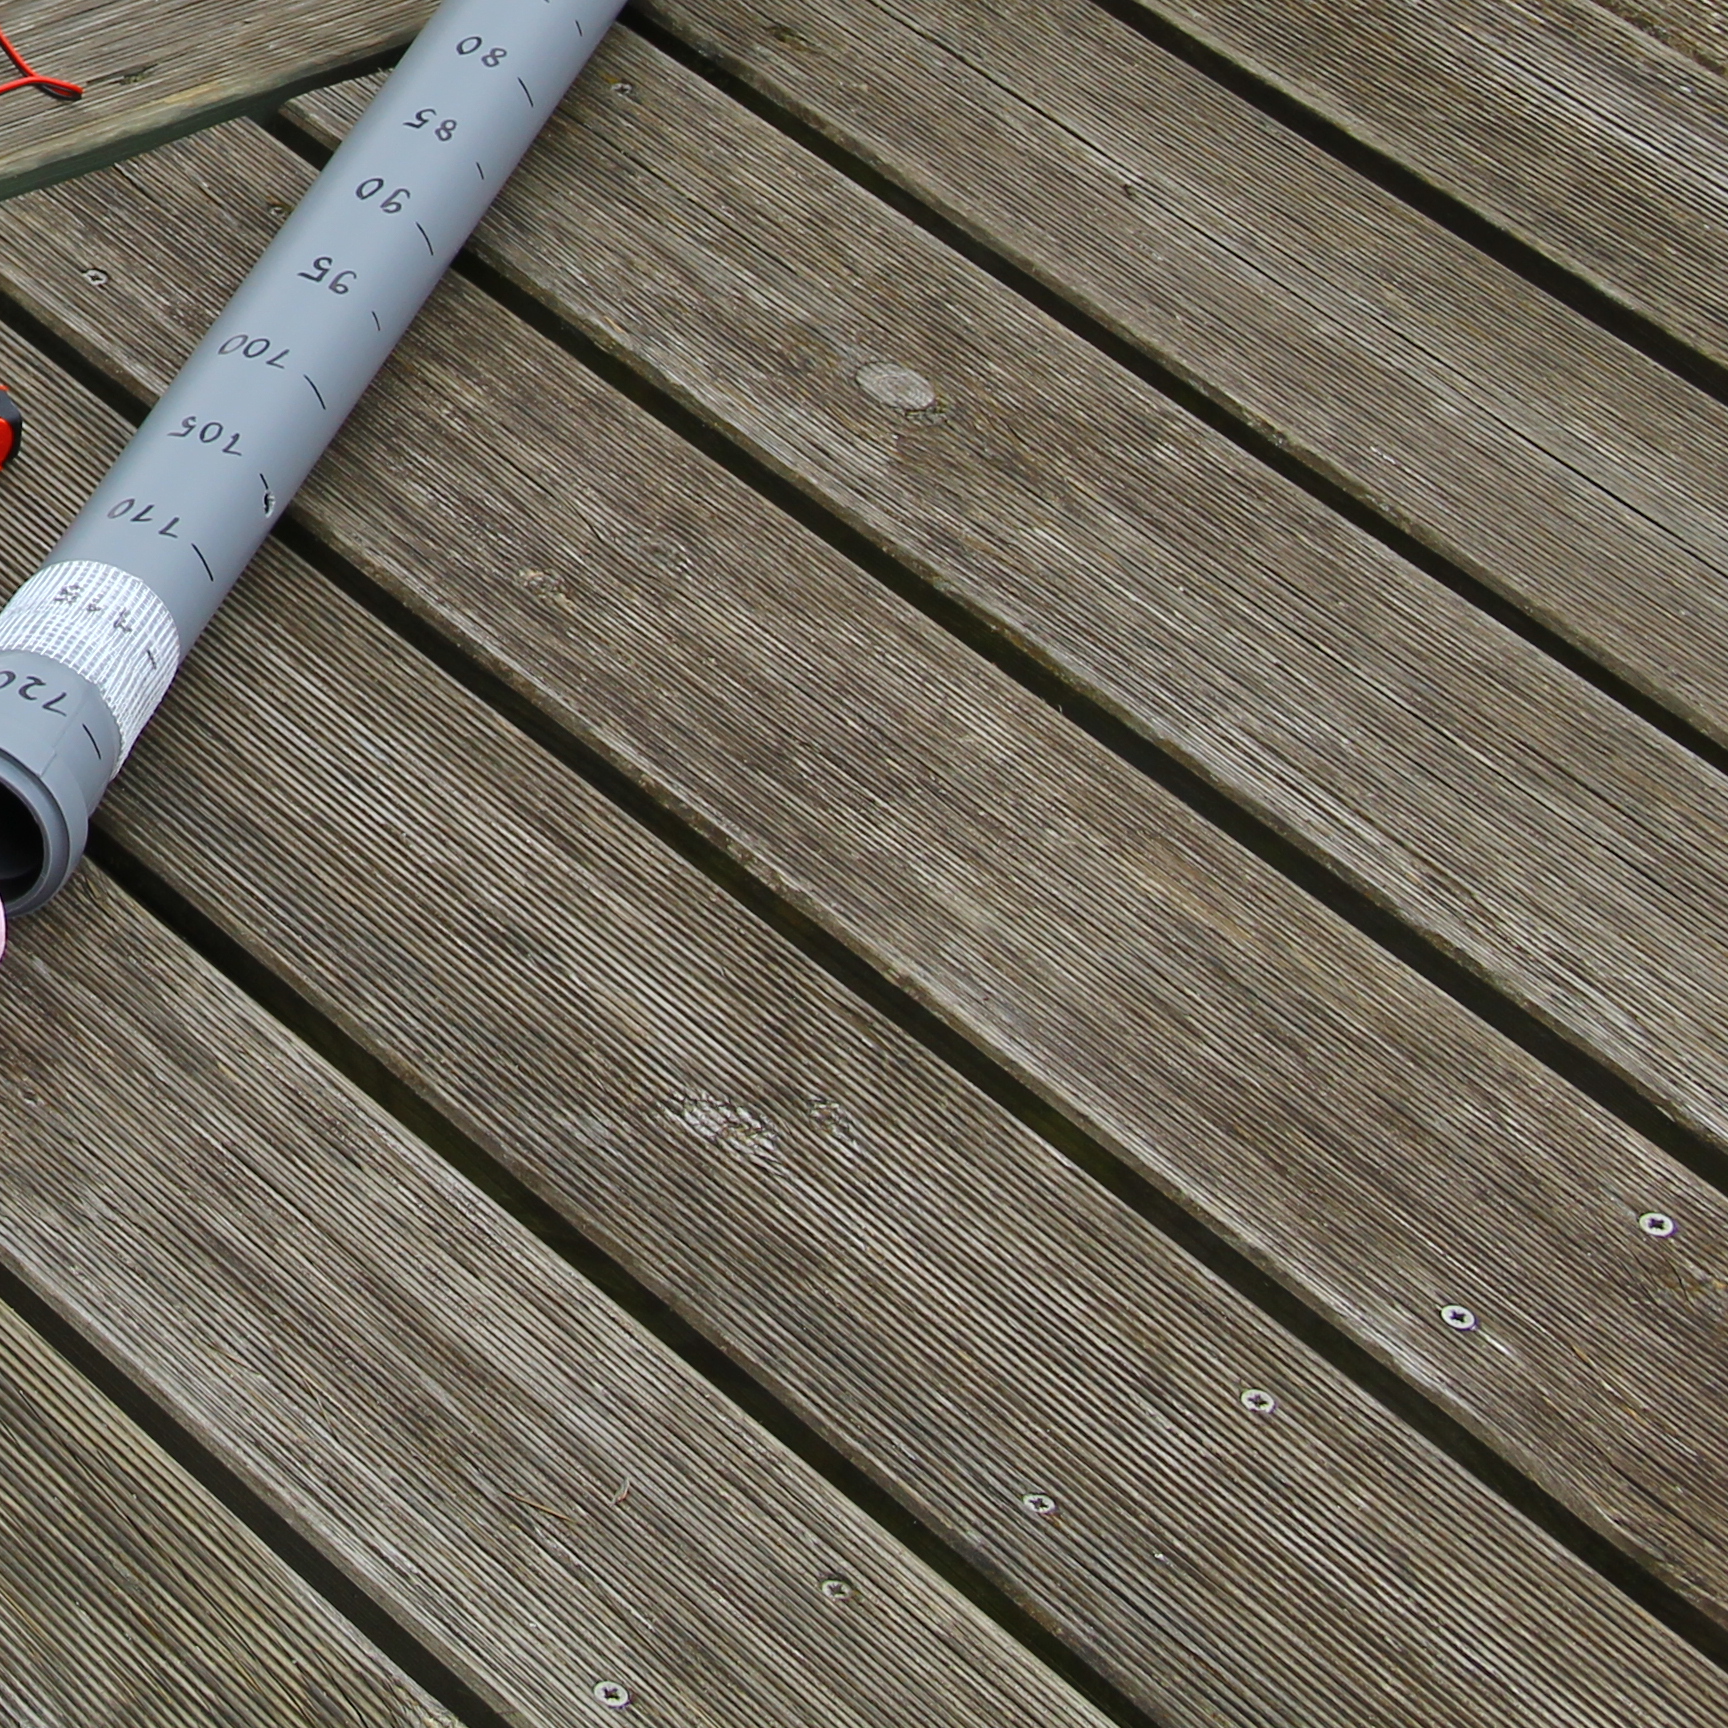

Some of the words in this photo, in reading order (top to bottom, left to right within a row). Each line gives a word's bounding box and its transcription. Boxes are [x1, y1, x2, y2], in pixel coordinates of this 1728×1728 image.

[456, 36, 508, 68] 80
[403, 108, 457, 142] 85
[355, 178, 411, 214] 90
[297, 256, 357, 295] 95
